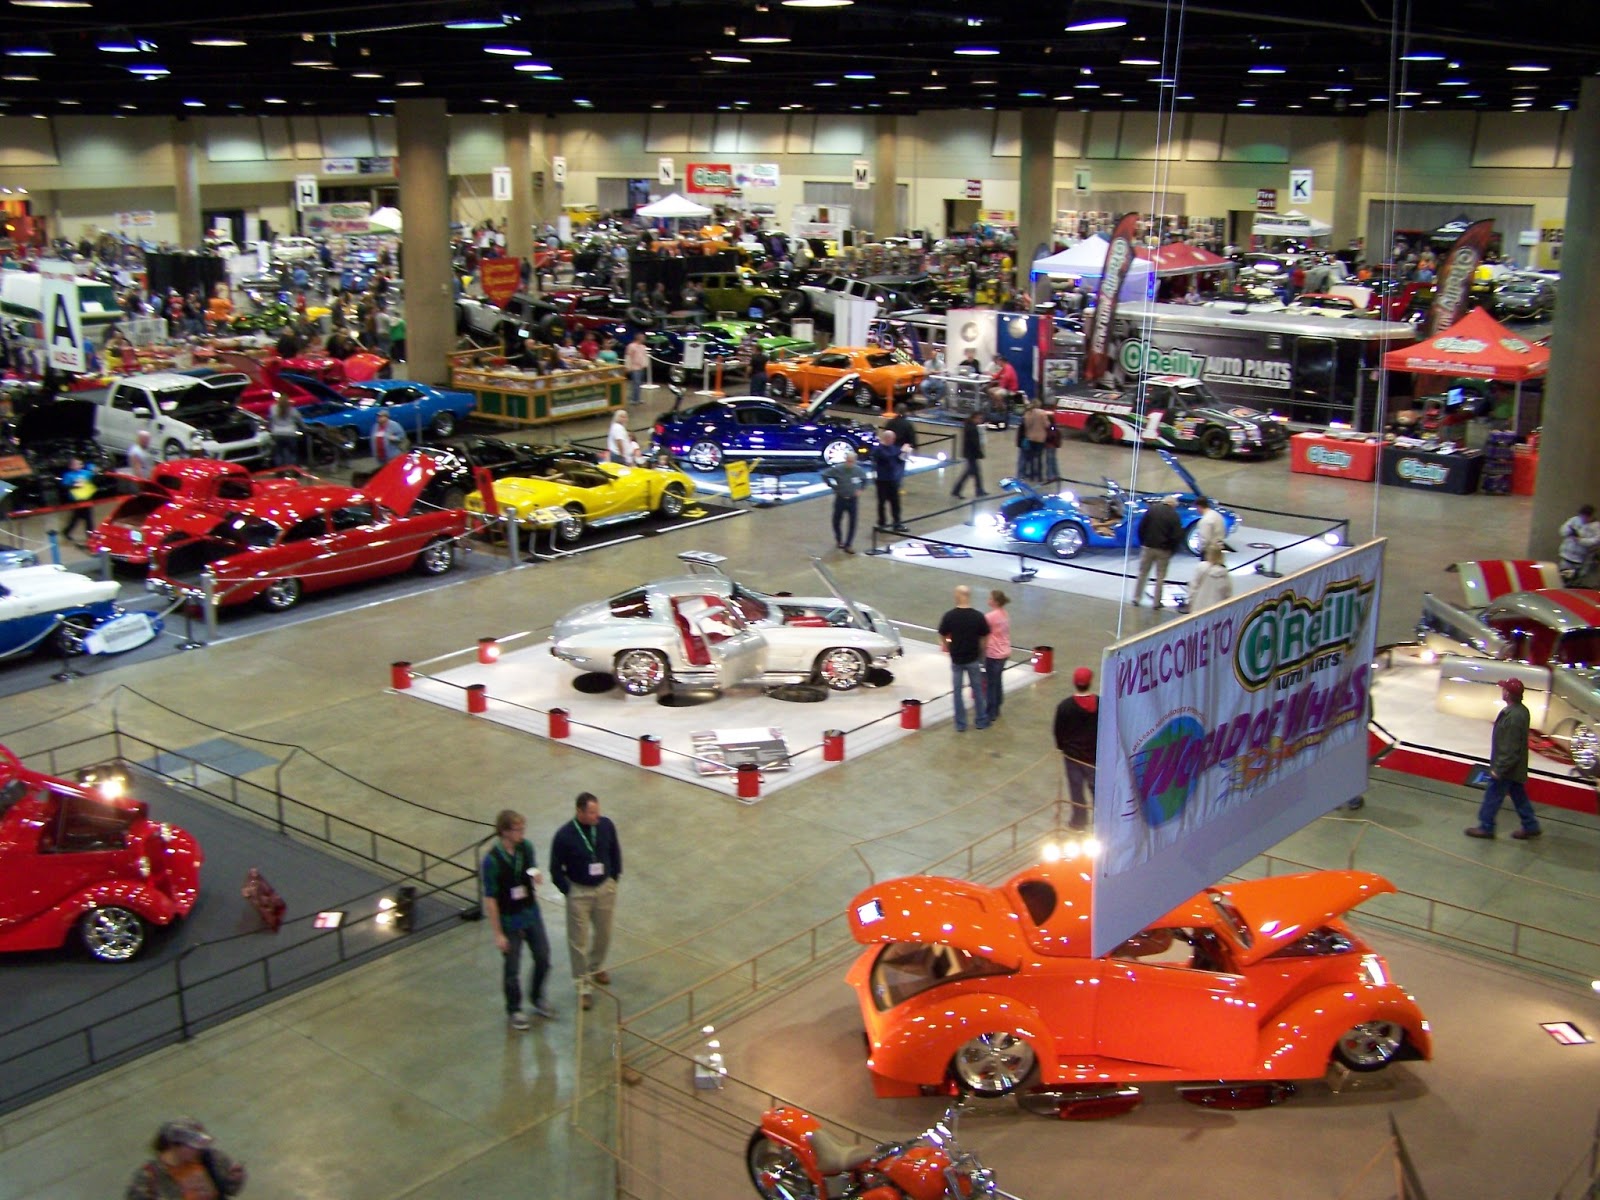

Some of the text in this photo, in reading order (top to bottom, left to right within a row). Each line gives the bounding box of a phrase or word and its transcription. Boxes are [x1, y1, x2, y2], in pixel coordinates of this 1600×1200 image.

[1076, 173, 1087, 190] L
[1294, 179, 1308, 197] K
[300, 185, 314, 203] H
[1257, 191, 1274, 199] Fire
[53, 293, 78, 349] A
[1204, 355, 1292, 381] AUTO PARTS
[1141, 411, 1165, 439] 1
[1243, 592, 1372, 678] O'Reilly
[1117, 616, 1234, 699] WELCOME TO
[1304, 652, 1342, 674] ARTS
